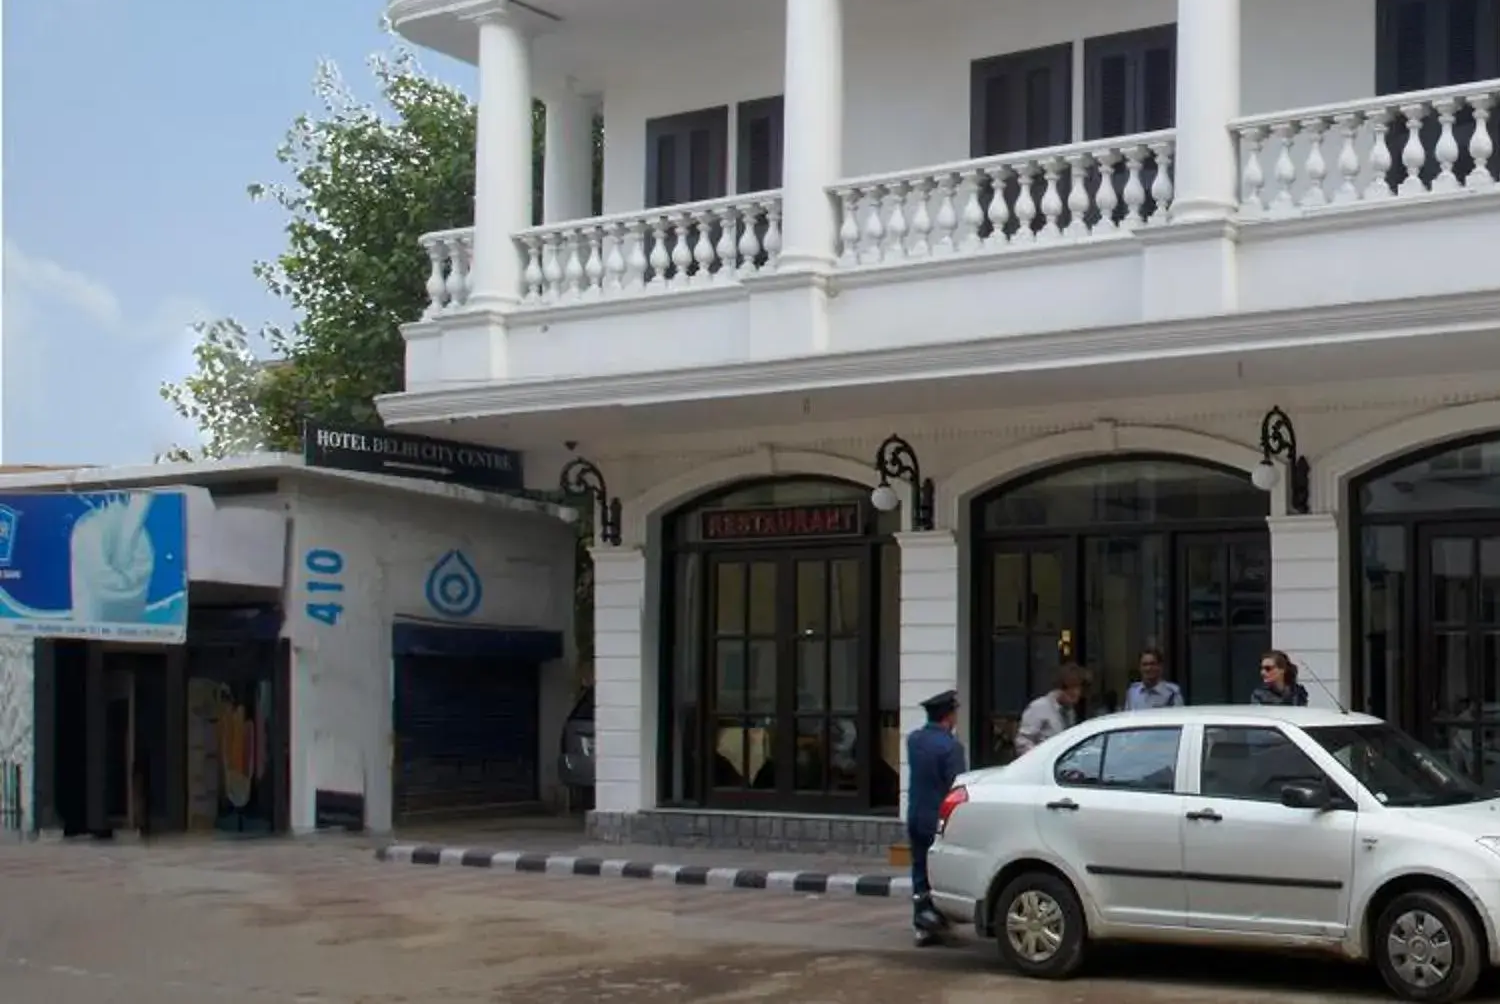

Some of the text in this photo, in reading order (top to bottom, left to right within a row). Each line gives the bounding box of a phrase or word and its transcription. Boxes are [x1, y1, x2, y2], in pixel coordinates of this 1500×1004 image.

[317, 428, 370, 452] HOTEL
[421, 444, 454, 463] CITY
[306, 550, 344, 626] 410
